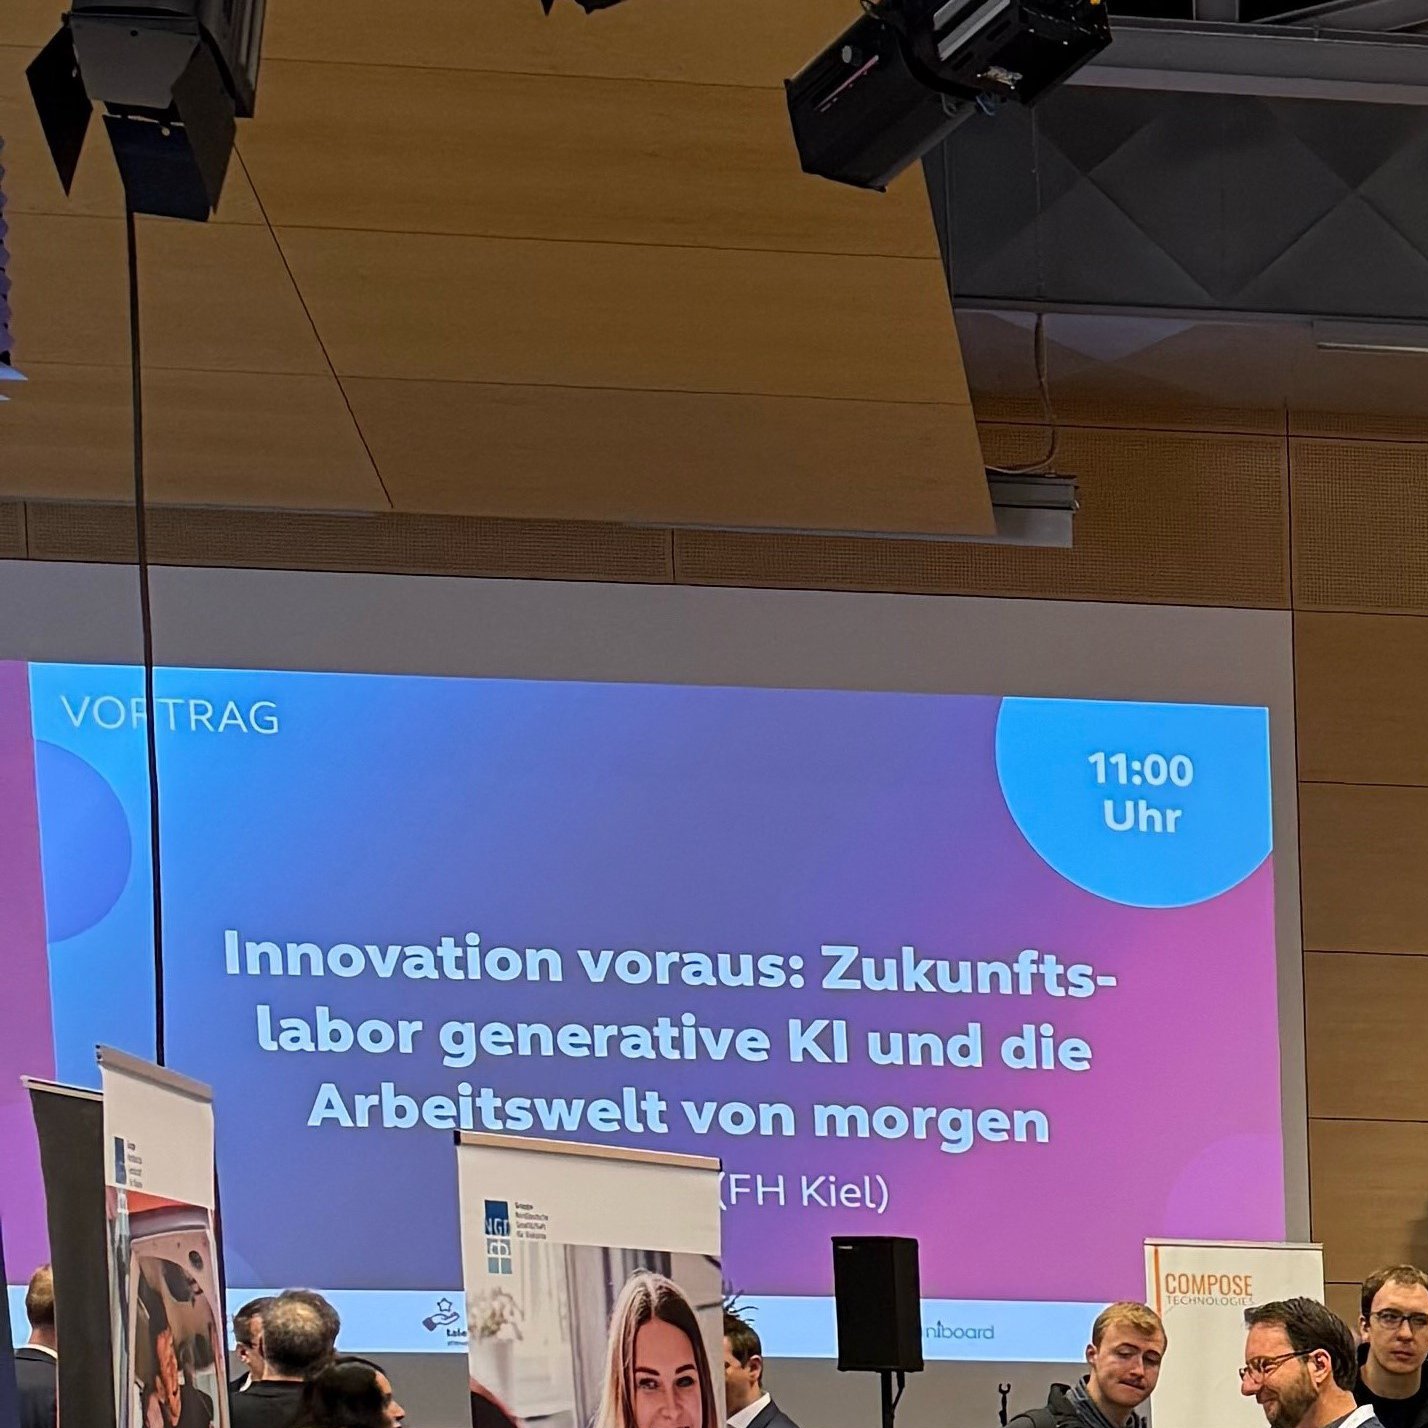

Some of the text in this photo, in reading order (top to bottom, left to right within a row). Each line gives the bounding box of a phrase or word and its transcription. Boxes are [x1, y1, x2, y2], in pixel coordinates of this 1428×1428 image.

[1088, 752, 1193, 786] 11:00
[1104, 800, 1181, 832] Uhr
[225, 930, 1116, 997] Innovation voraus: Zukunfts-
[257, 1005, 1092, 1070] labor generative KI und die
[308, 1082, 1048, 1153] Arbeitswelt von morgen
[800, 1175, 889, 1214] Kiel)
[1165, 1273, 1253, 1296] COMPOSE
